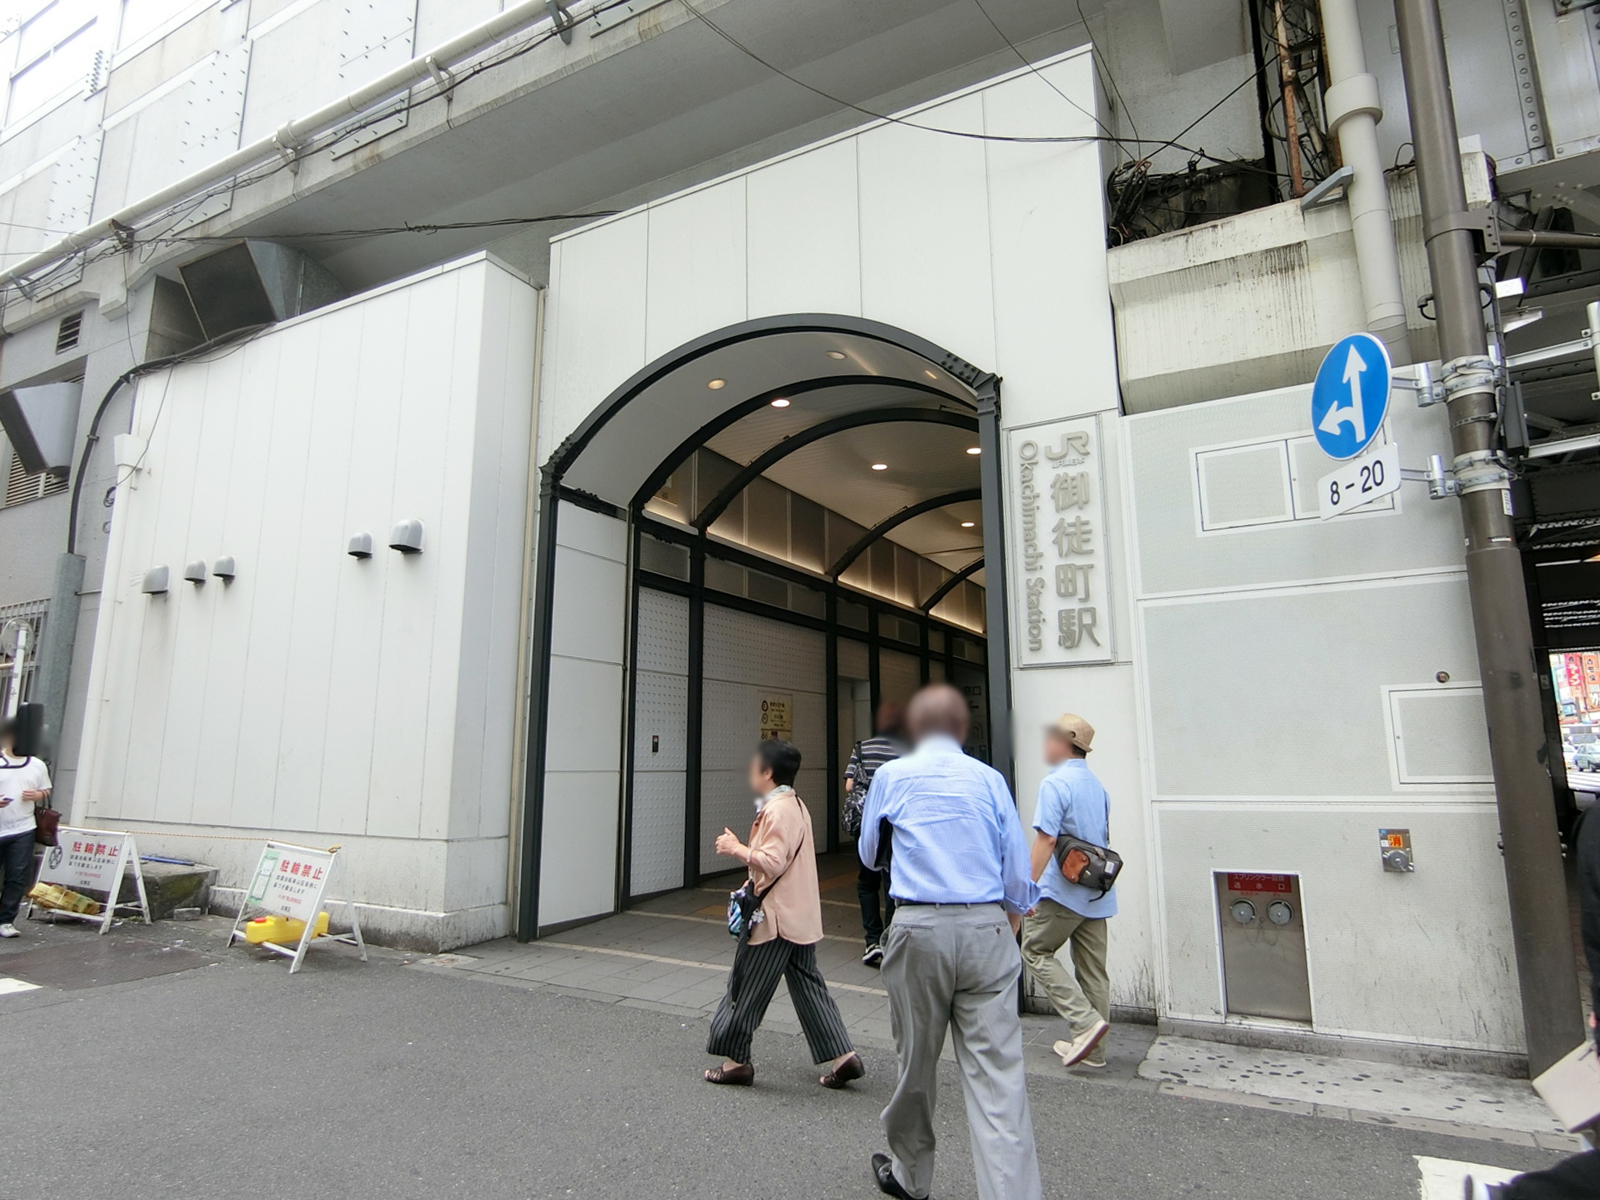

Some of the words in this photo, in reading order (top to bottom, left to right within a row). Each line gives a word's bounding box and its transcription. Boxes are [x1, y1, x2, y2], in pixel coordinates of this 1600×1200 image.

[1044, 430, 1090, 461] JR
[1330, 459, 1385, 506] 8-20
[1018, 440, 1044, 572] Okachimachi
[1050, 471, 1101, 649] 御徒町駅
[1025, 577, 1047, 651] Station
[72, 841, 119, 857] 駐輪禁止
[1389, 835, 1402, 847] 消
[280, 859, 323, 880] 駐輪禁止
